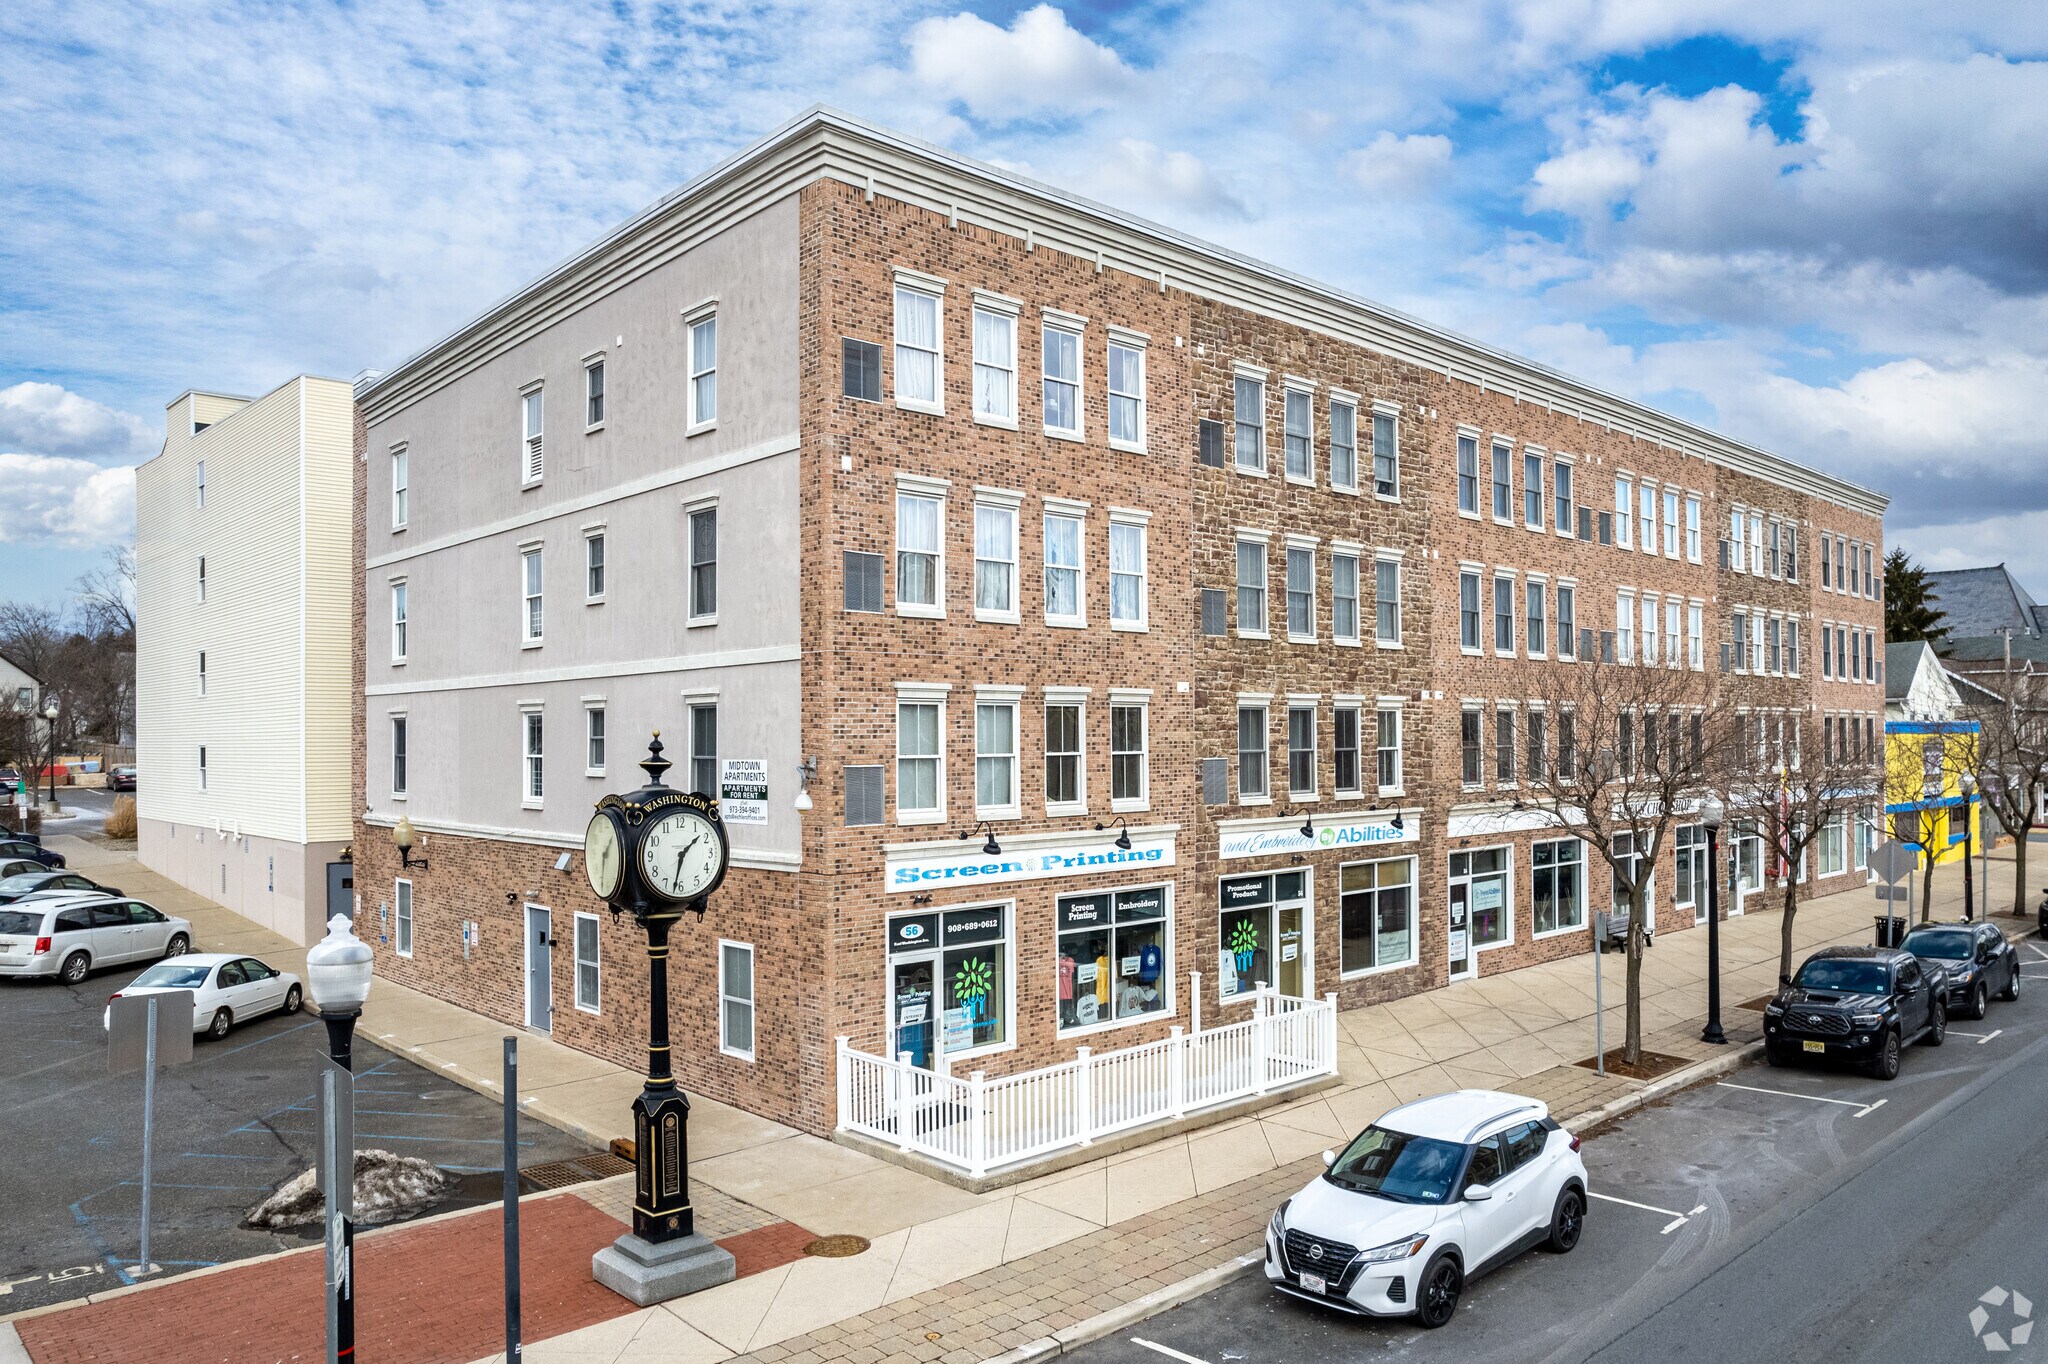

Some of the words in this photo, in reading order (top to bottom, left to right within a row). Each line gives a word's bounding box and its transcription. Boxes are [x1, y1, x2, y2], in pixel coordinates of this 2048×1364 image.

[728, 761, 761, 771] MIDTOWN
[724, 771, 766, 782] APARTMENTS
[723, 784, 766, 793] APARTMENTS
[730, 791, 741, 799] FOR
[643, 794, 707, 813] WASHINGTON
[662, 822, 670, 834] 11
[676, 817, 685, 829] 12
[693, 821, 697, 833] 1
[650, 835, 660, 848] 10
[703, 832, 709, 844] 2
[1223, 838, 1251, 853] and
[1321, 832, 1334, 844] By
[1336, 826, 1403, 844] Abilities
[647, 851, 654, 863] 9
[708, 848, 714, 859] 3
[651, 865, 659, 878] 8
[703, 862, 710, 874] 4
[895, 862, 1023, 884] Screen
[1040, 849, 1164, 871] Printing
[661, 878, 669, 890] 7
[678, 881, 684, 893] 6
[693, 875, 700, 887] 5
[1227, 882, 1262, 892] Promotional
[1232, 890, 1258, 899] Products
[1071, 903, 1095, 913] Screen
[1118, 900, 1159, 910] Embroidery
[1068, 911, 1097, 921] Printing
[905, 926, 918, 936] 56
